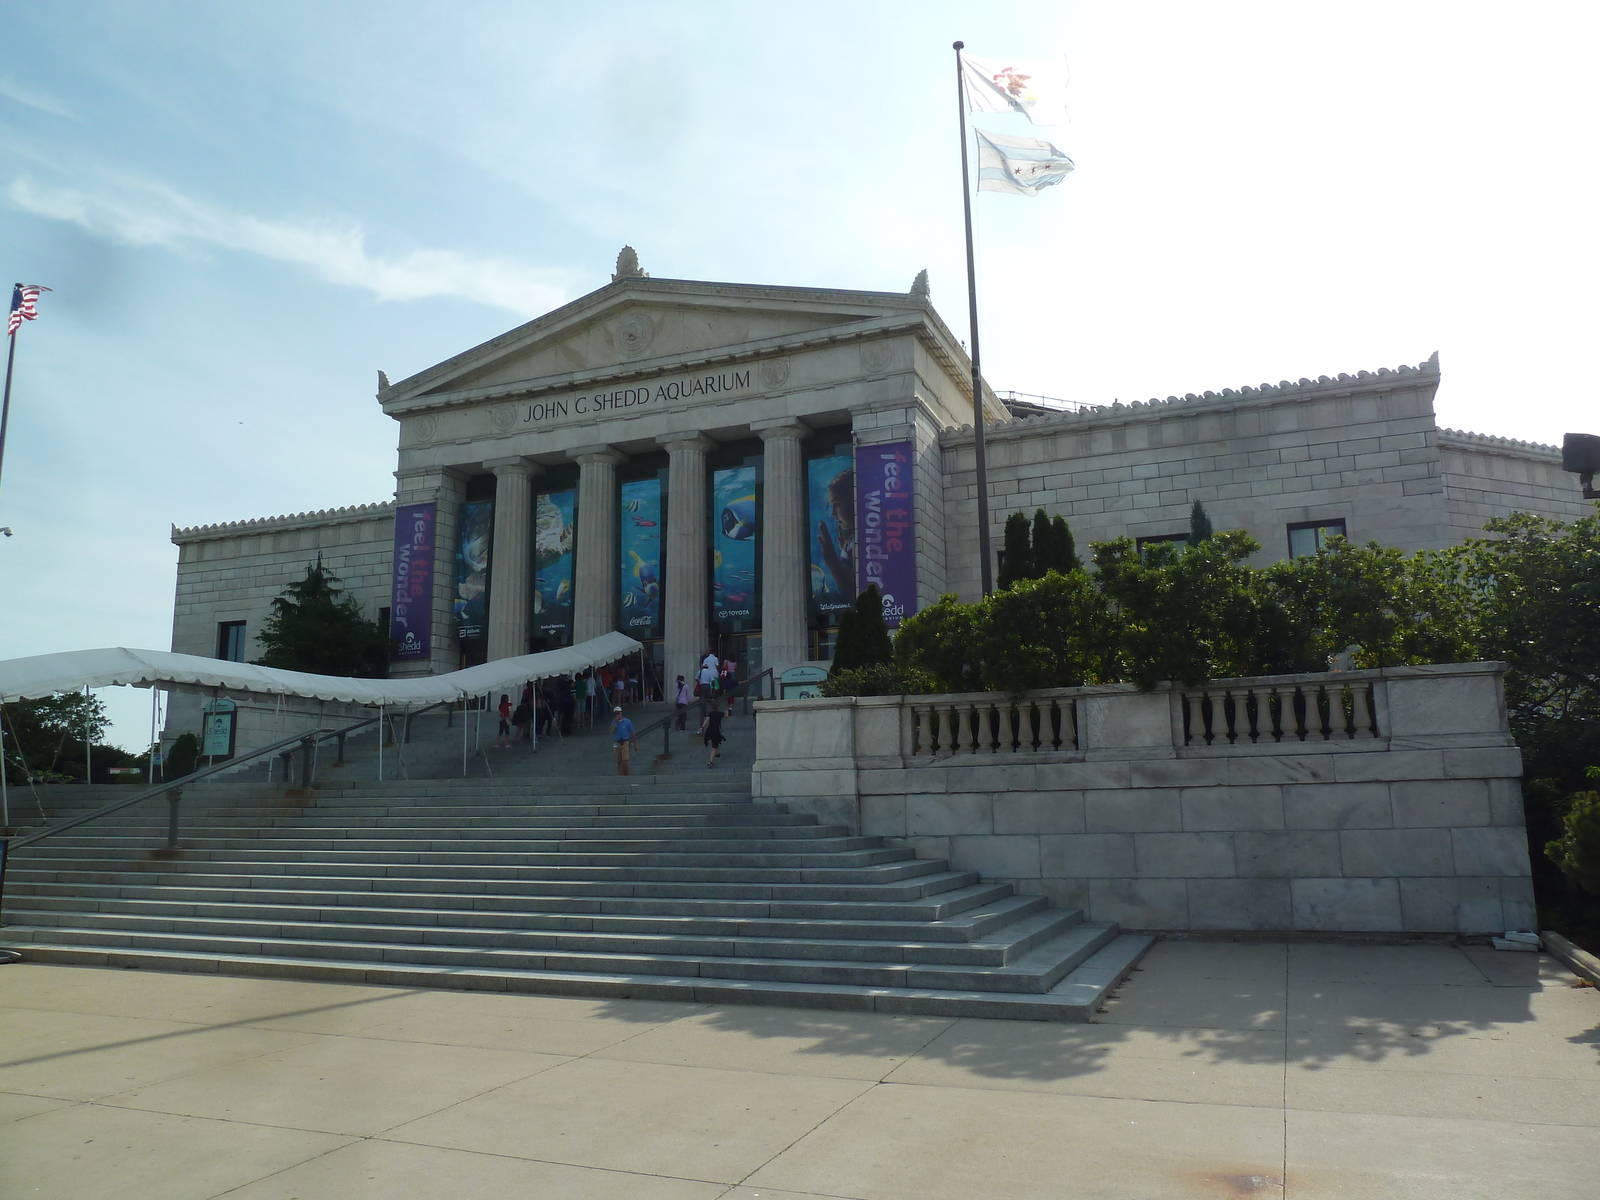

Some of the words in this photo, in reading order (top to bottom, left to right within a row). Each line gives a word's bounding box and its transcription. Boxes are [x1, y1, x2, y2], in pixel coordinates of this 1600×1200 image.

[523, 400, 569, 423] JOHN
[575, 397, 590, 414] G.
[593, 387, 650, 412] SHEDD
[655, 370, 751, 401] AQUARIUM
[880, 451, 908, 498] feel
[413, 512, 432, 550] feel
[865, 490, 889, 588] wonder
[885, 508, 910, 552] the
[395, 543, 413, 628] wonder
[411, 560, 430, 597] the
[728, 609, 750, 617] TOYOTA
